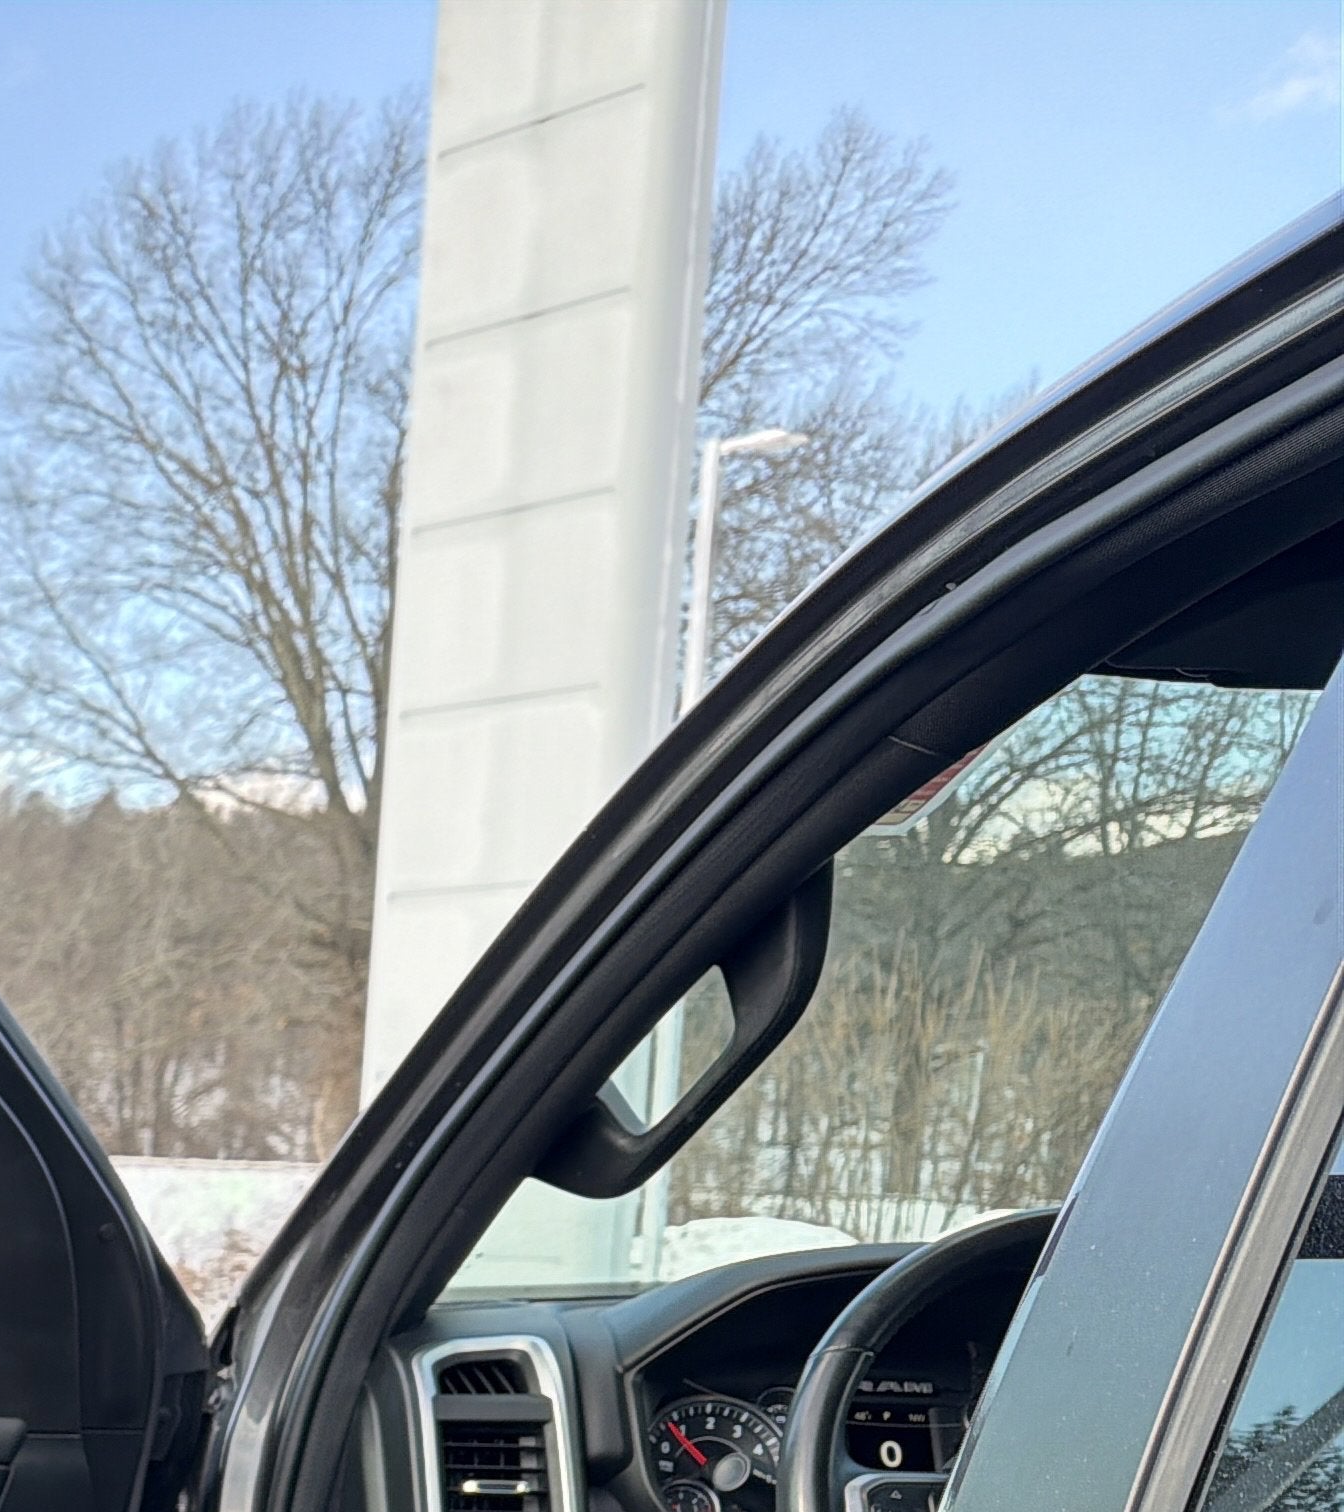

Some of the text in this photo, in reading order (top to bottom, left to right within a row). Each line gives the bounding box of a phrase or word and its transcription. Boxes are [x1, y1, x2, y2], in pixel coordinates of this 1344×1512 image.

[705, 1416, 716, 1430] 2
[732, 1424, 743, 1439] 3
[880, 1440, 902, 1468] 0
